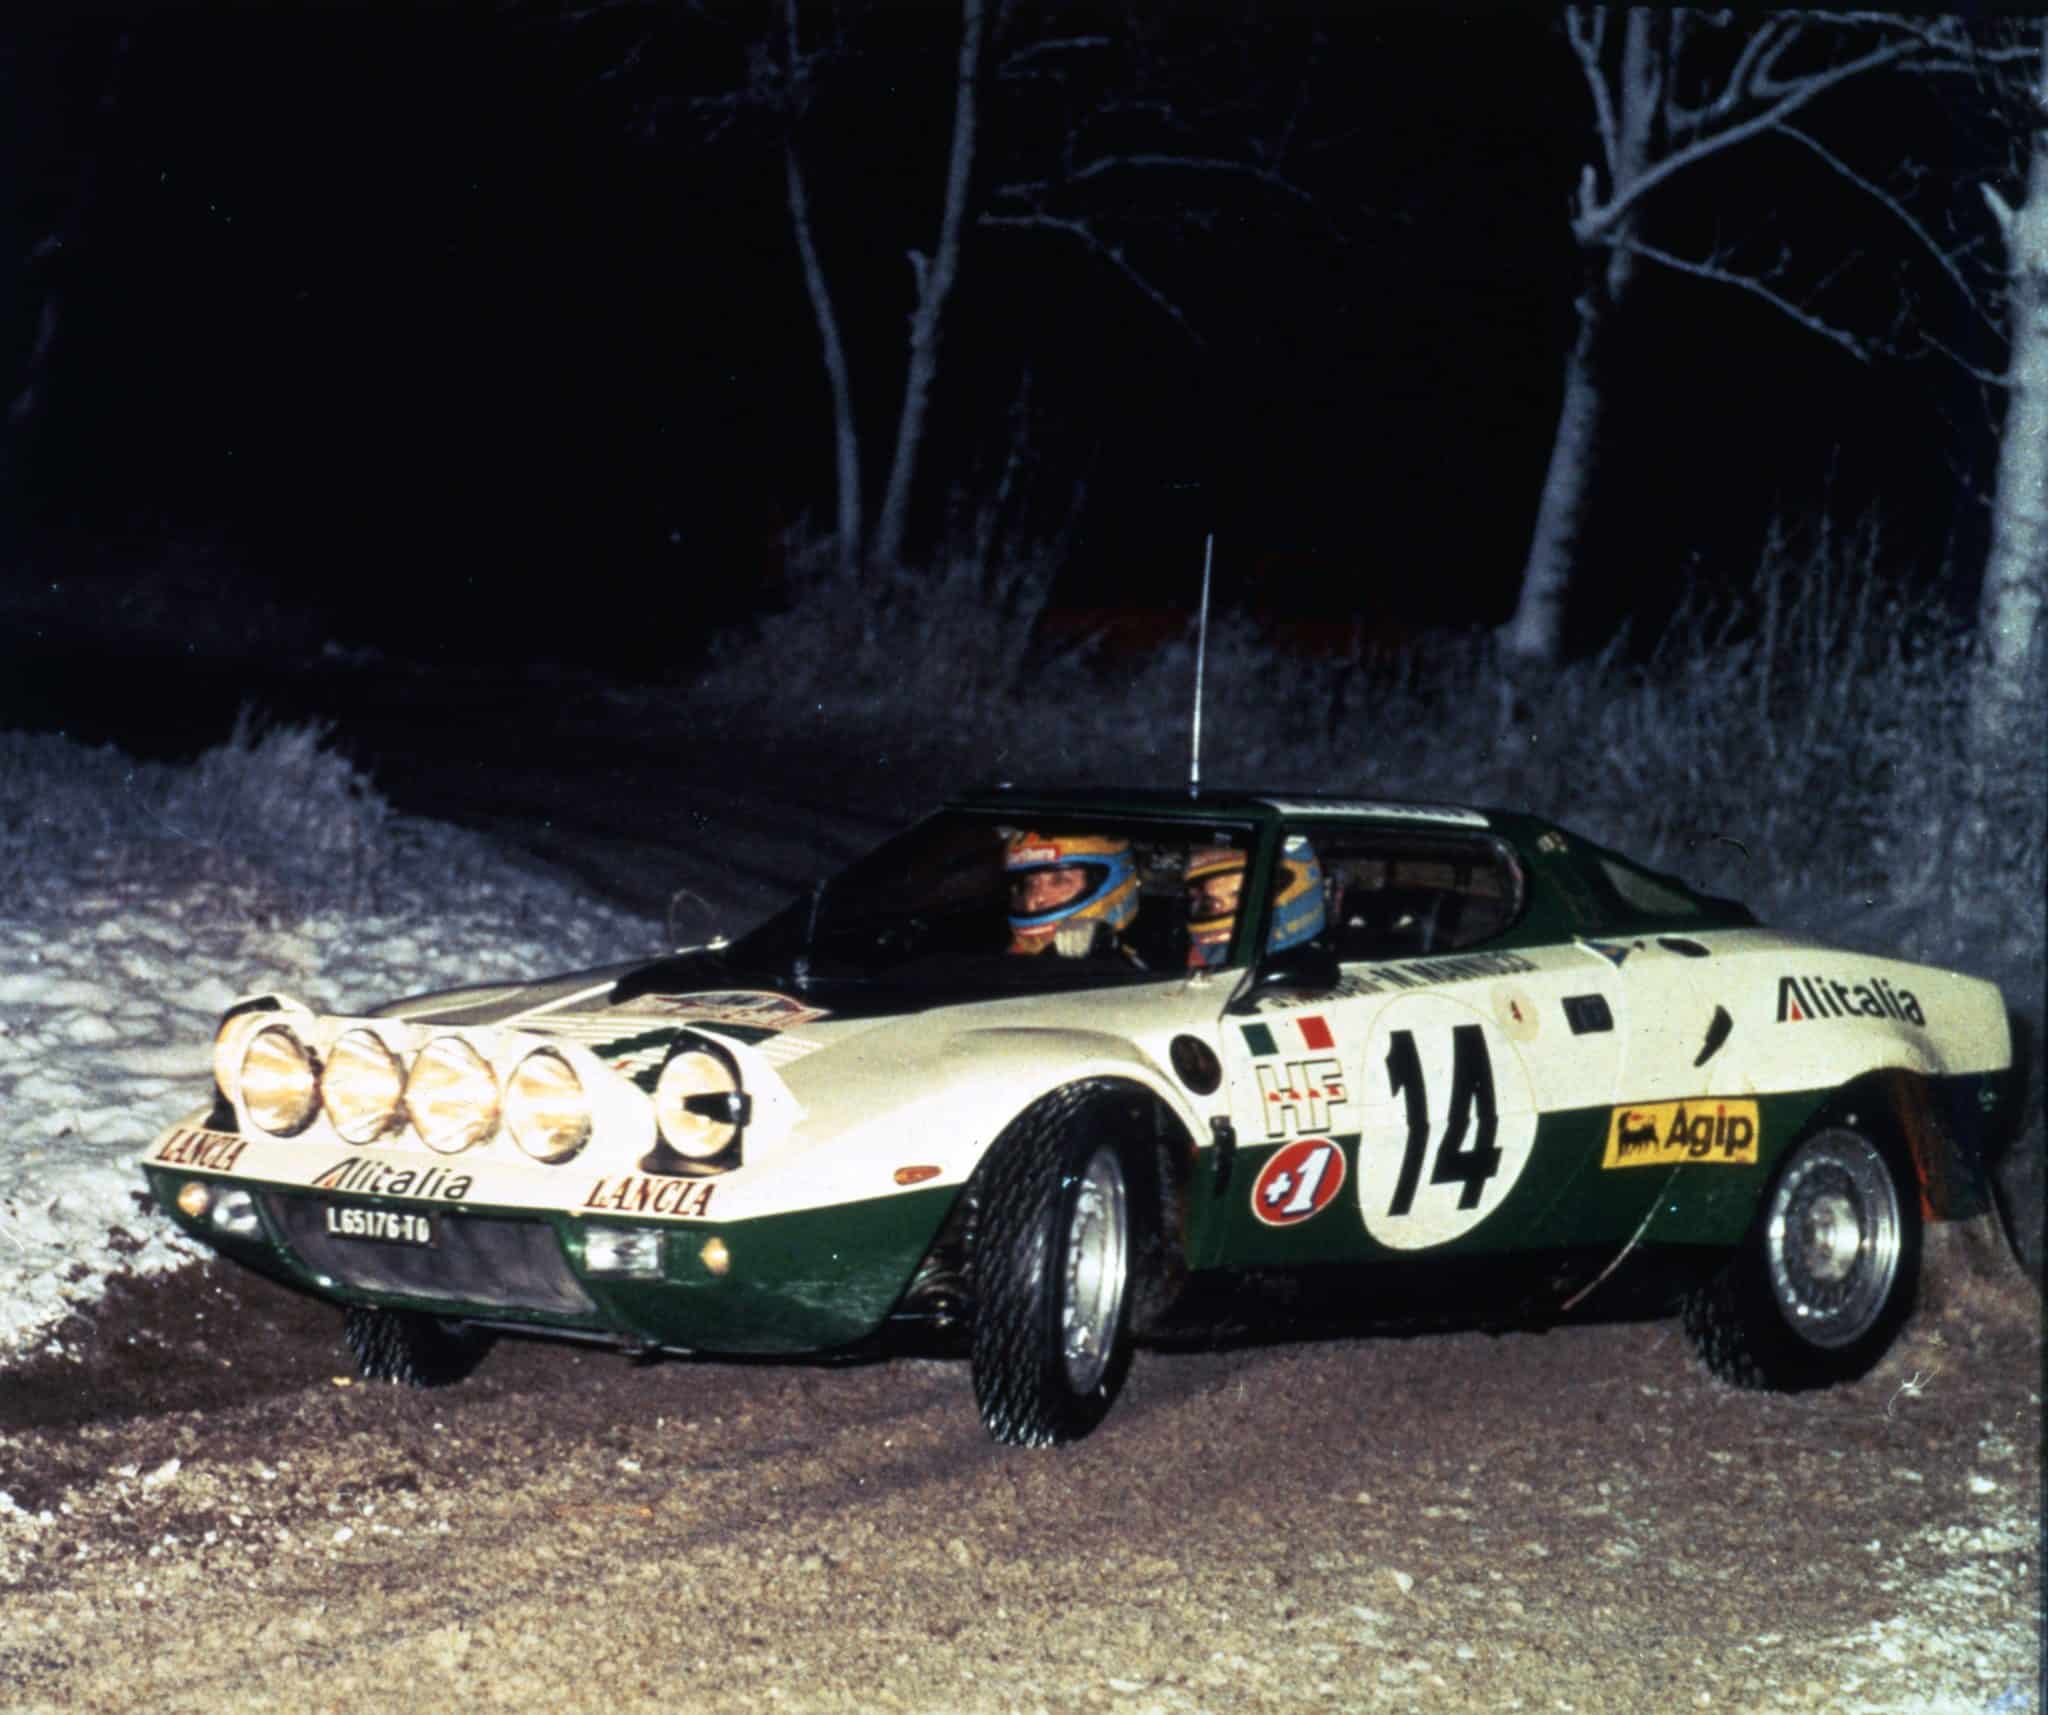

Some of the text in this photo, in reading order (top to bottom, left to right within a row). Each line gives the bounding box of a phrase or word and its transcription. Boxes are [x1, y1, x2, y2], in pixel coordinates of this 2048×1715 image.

[1777, 976, 1925, 1027] Alitalia
[1255, 1058, 1347, 1138] HF
[1385, 1024, 1503, 1217] 14
[155, 1129, 248, 1171] LANCIA
[1664, 1103, 1754, 1156] Agip
[311, 1157, 473, 1200] Alitalia
[584, 1176, 716, 1216] LANCIA
[1264, 1146, 1332, 1215] +1
